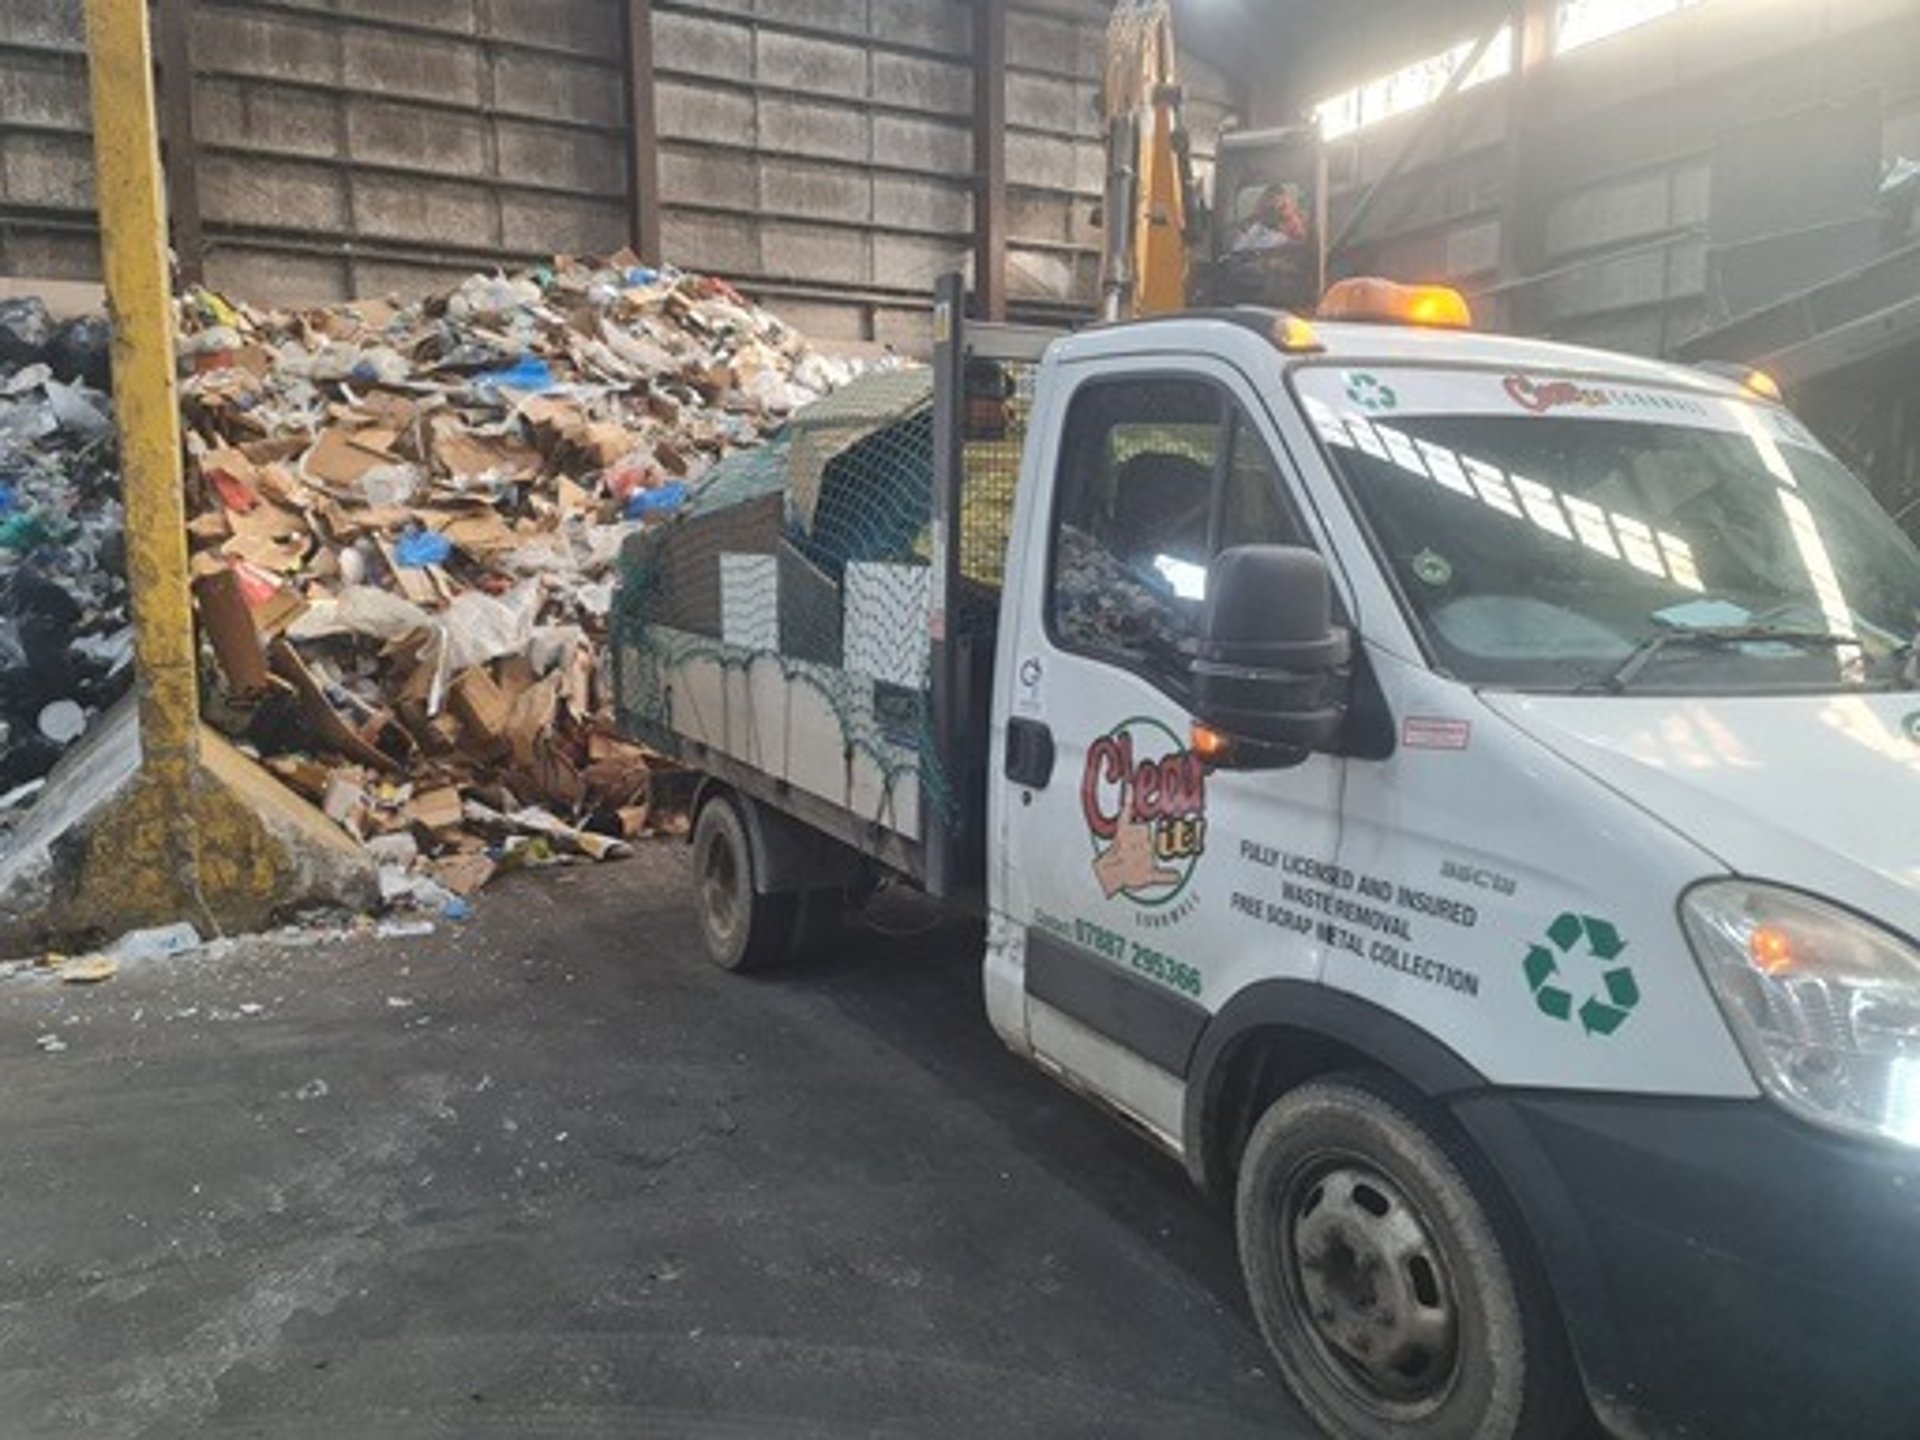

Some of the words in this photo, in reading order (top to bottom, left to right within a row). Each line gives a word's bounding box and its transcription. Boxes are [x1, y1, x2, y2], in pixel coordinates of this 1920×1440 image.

[1241, 839, 1280, 868] FULLY
[1282, 853, 1354, 889] LICENSED
[1357, 874, 1392, 902] AND
[1398, 885, 1478, 928] INSURED
[1231, 891, 1262, 920] FREE
[1266, 903, 1314, 934] SCRAP
[1316, 922, 1365, 957] METAL
[1369, 940, 1479, 997] COLLECTION
